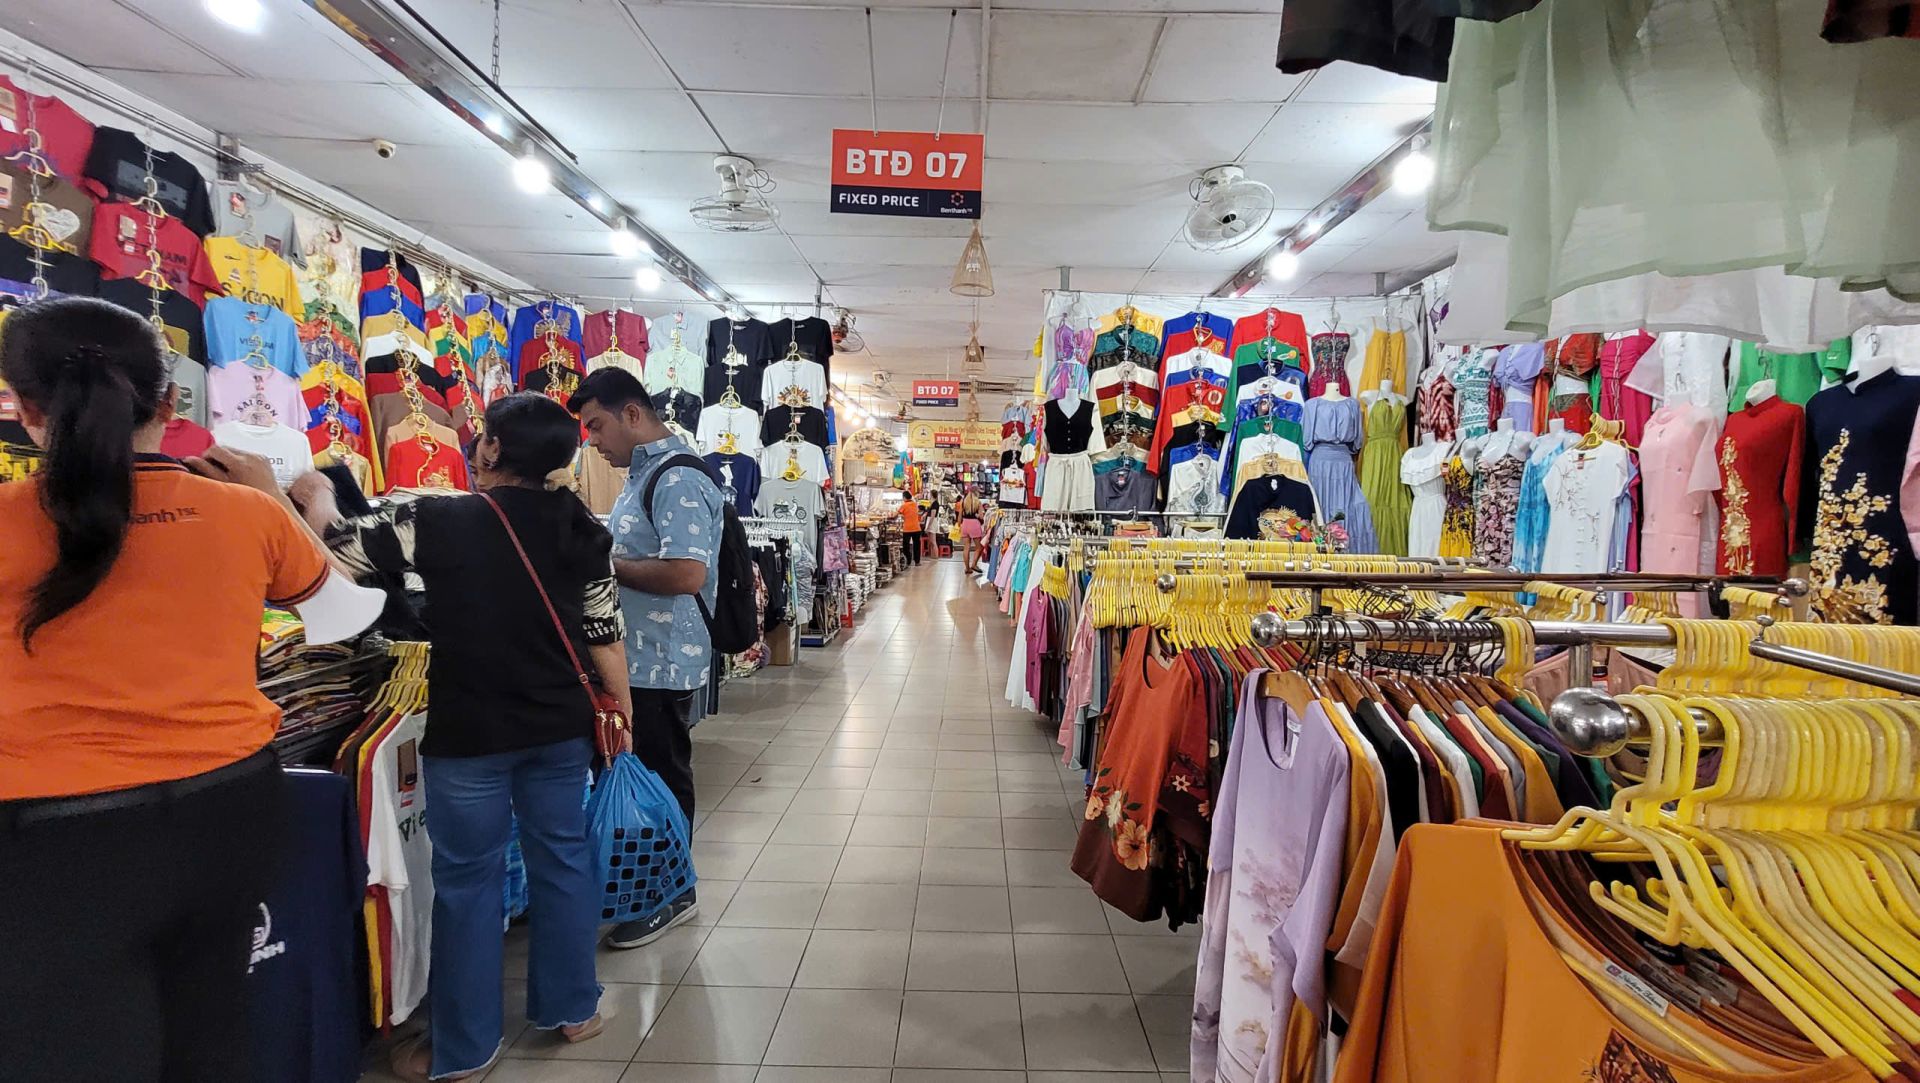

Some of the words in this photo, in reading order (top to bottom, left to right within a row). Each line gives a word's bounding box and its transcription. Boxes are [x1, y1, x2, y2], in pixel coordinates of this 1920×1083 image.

[846, 148, 913, 176] BTĐ
[925, 151, 968, 179] 07
[838, 192, 878, 206] FIXED
[881, 194, 920, 208] PRICE
[221, 282, 285, 311] SIGON
[940, 386, 954, 395] 07
[237, 399, 279, 418] SAIGON
[399, 810, 426, 842] Vie
